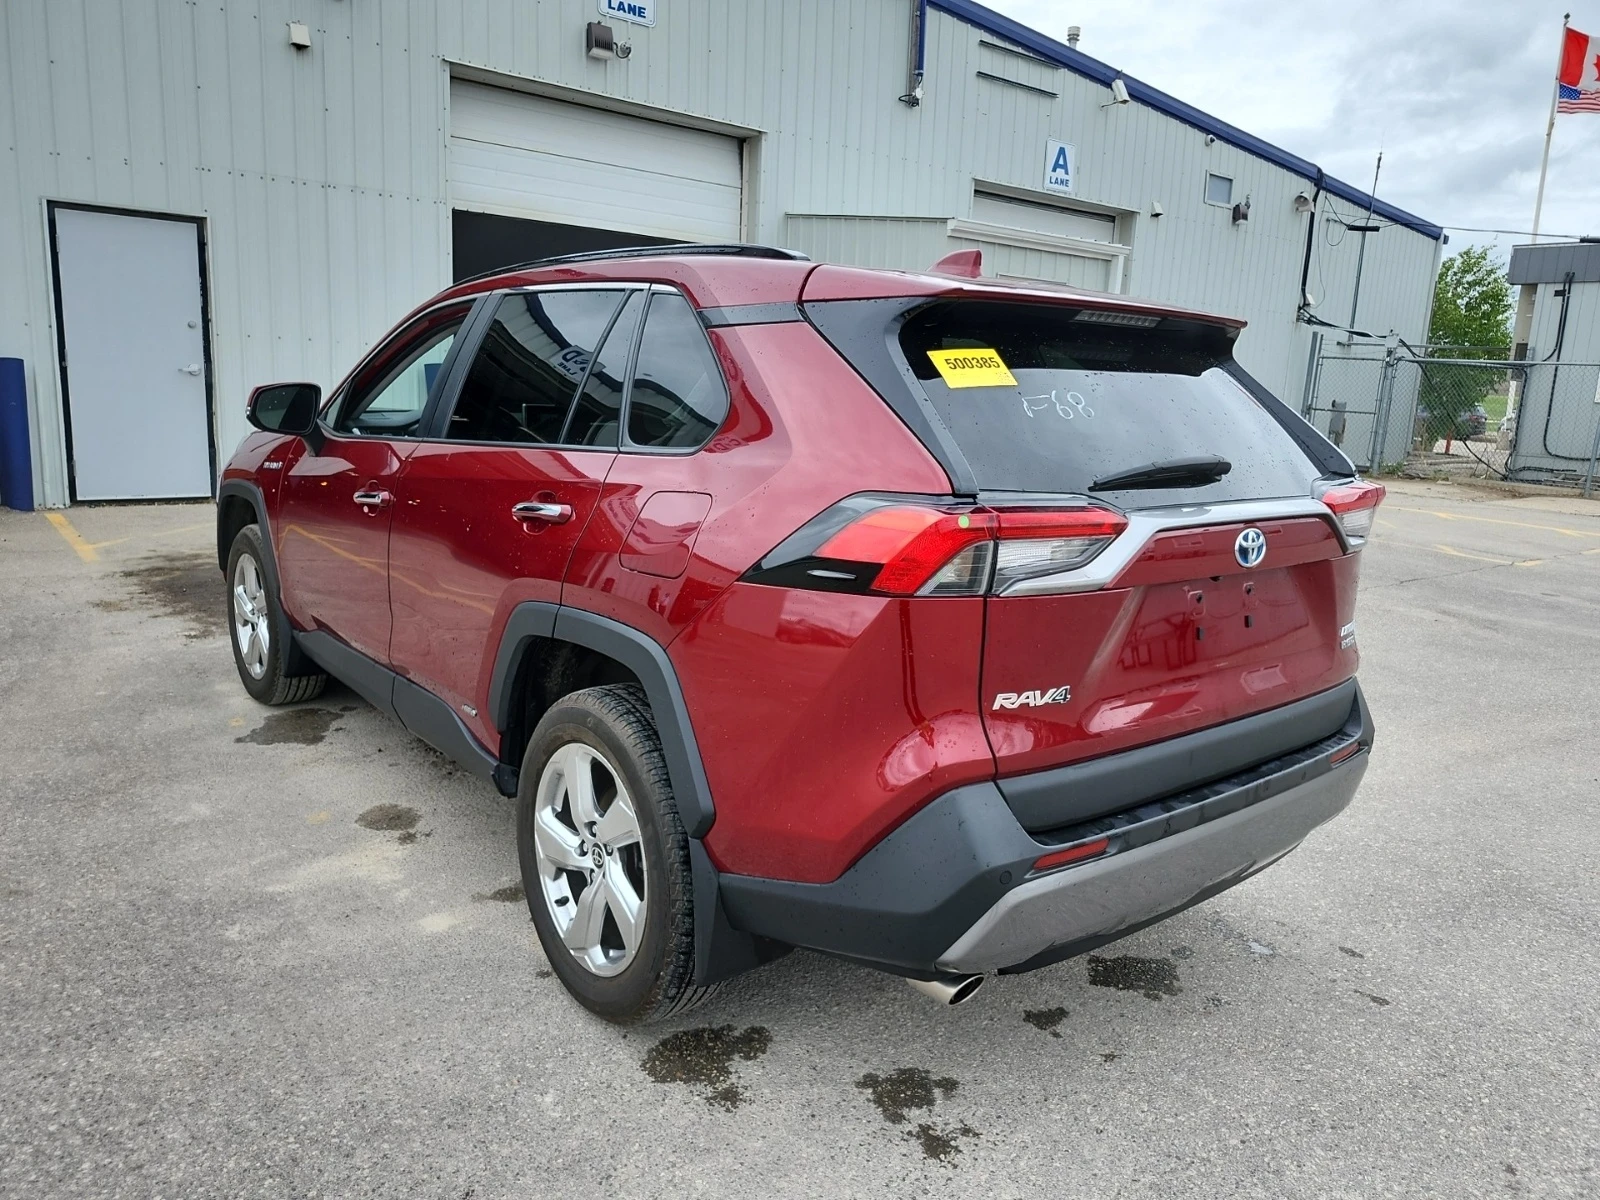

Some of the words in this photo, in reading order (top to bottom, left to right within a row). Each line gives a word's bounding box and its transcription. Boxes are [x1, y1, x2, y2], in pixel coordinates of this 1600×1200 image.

[608, 0, 646, 19] LANE
[1051, 146, 1069, 175] A
[1049, 176, 1069, 188] LANE
[944, 357, 1001, 370] 500385
[992, 685, 1071, 711] RAV4
